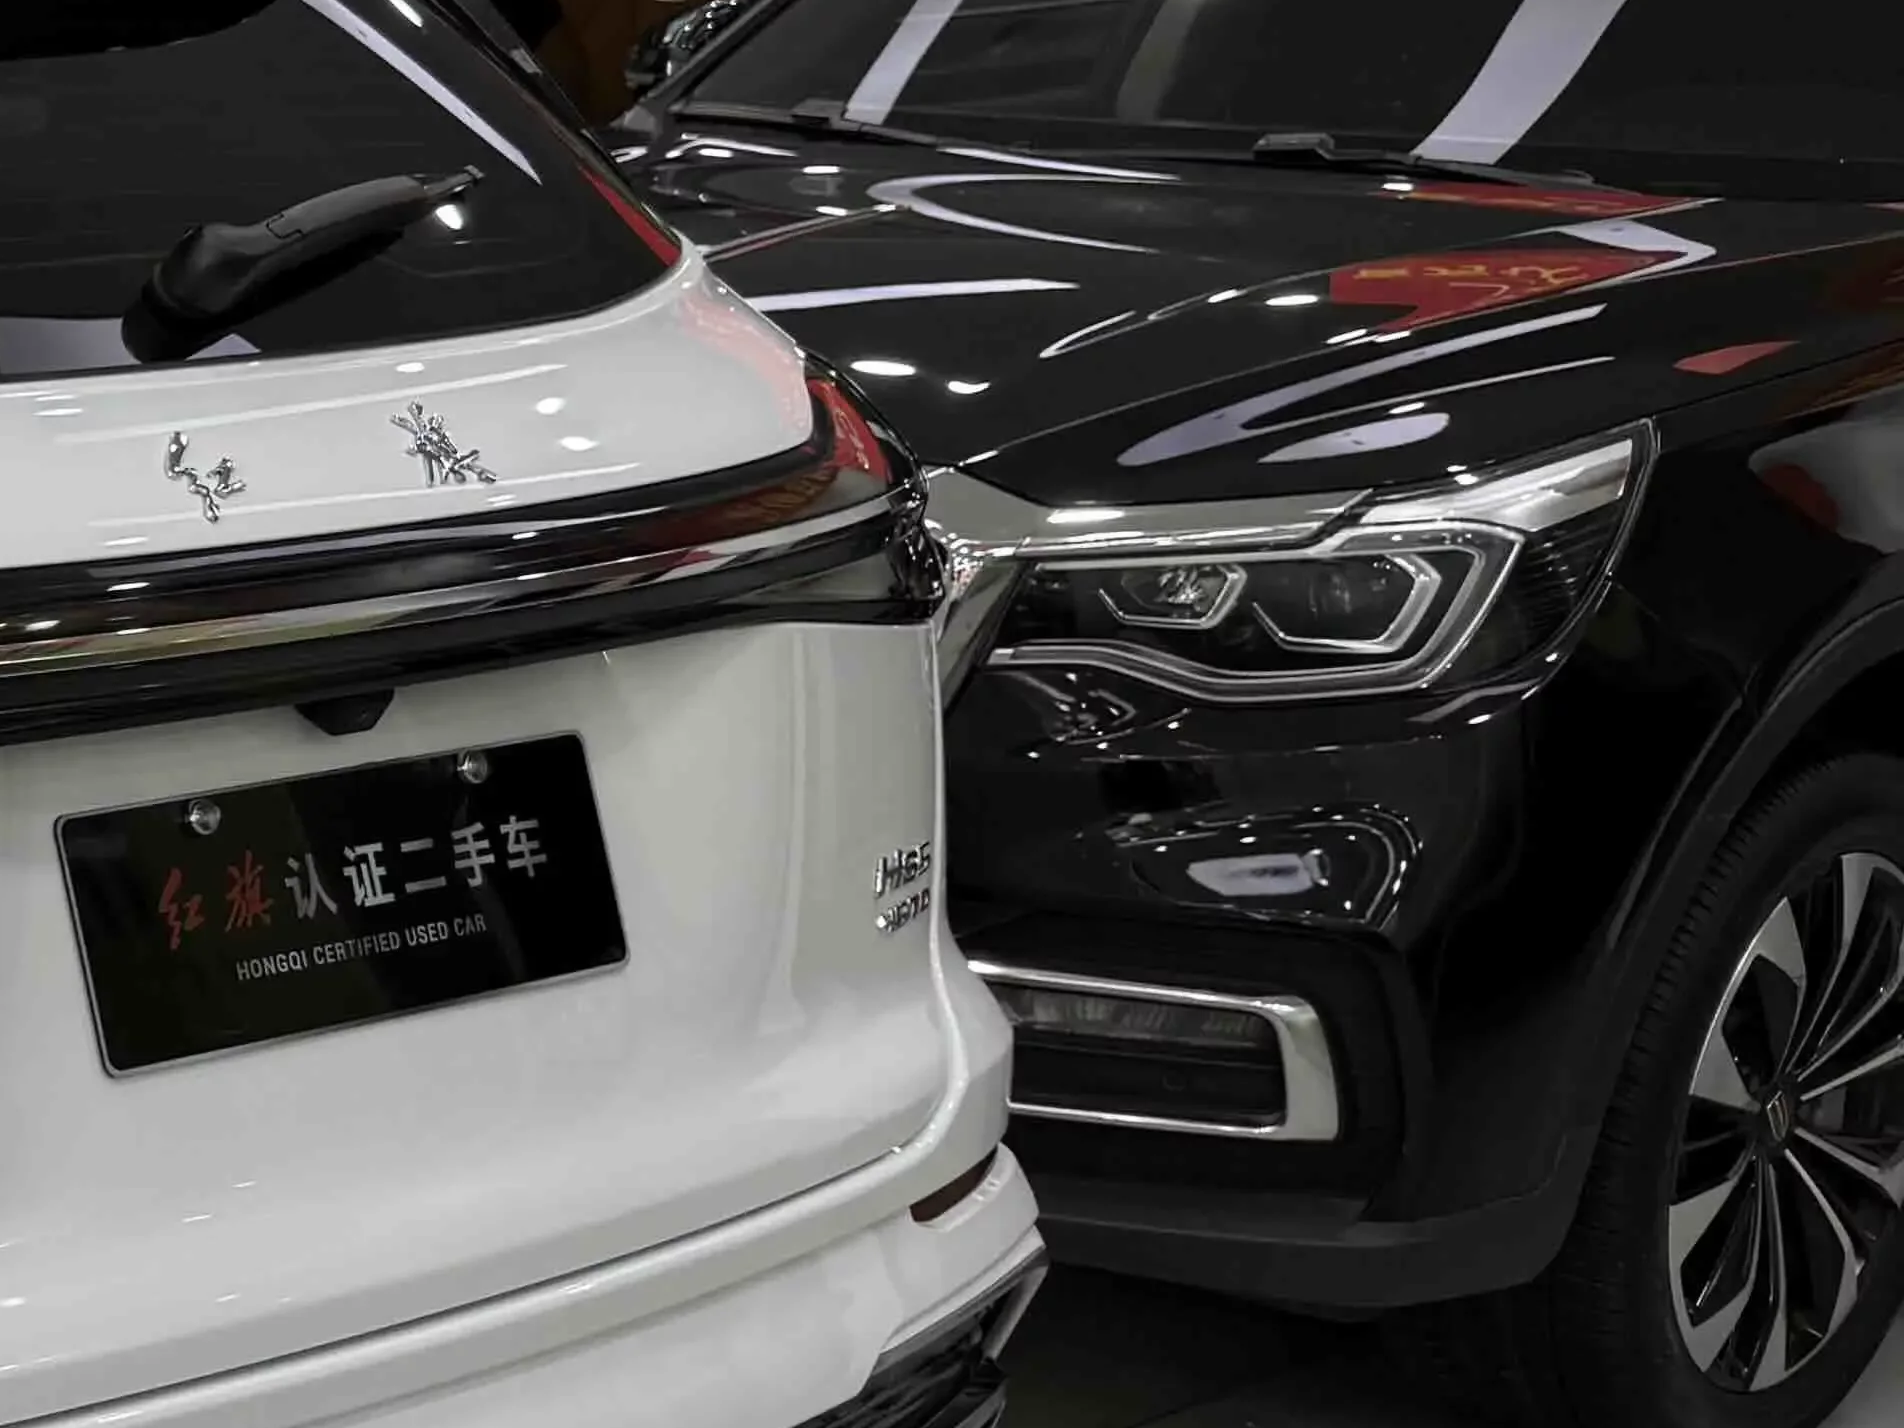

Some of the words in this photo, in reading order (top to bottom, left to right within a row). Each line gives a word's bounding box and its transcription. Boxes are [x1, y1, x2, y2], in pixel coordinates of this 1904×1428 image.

[157, 813, 548, 951] 红旗认证二手车
[235, 948, 308, 981] HONGQI
[312, 931, 401, 966] CERTIFIED
[404, 921, 449, 947] USED
[453, 913, 487, 937] CAR
